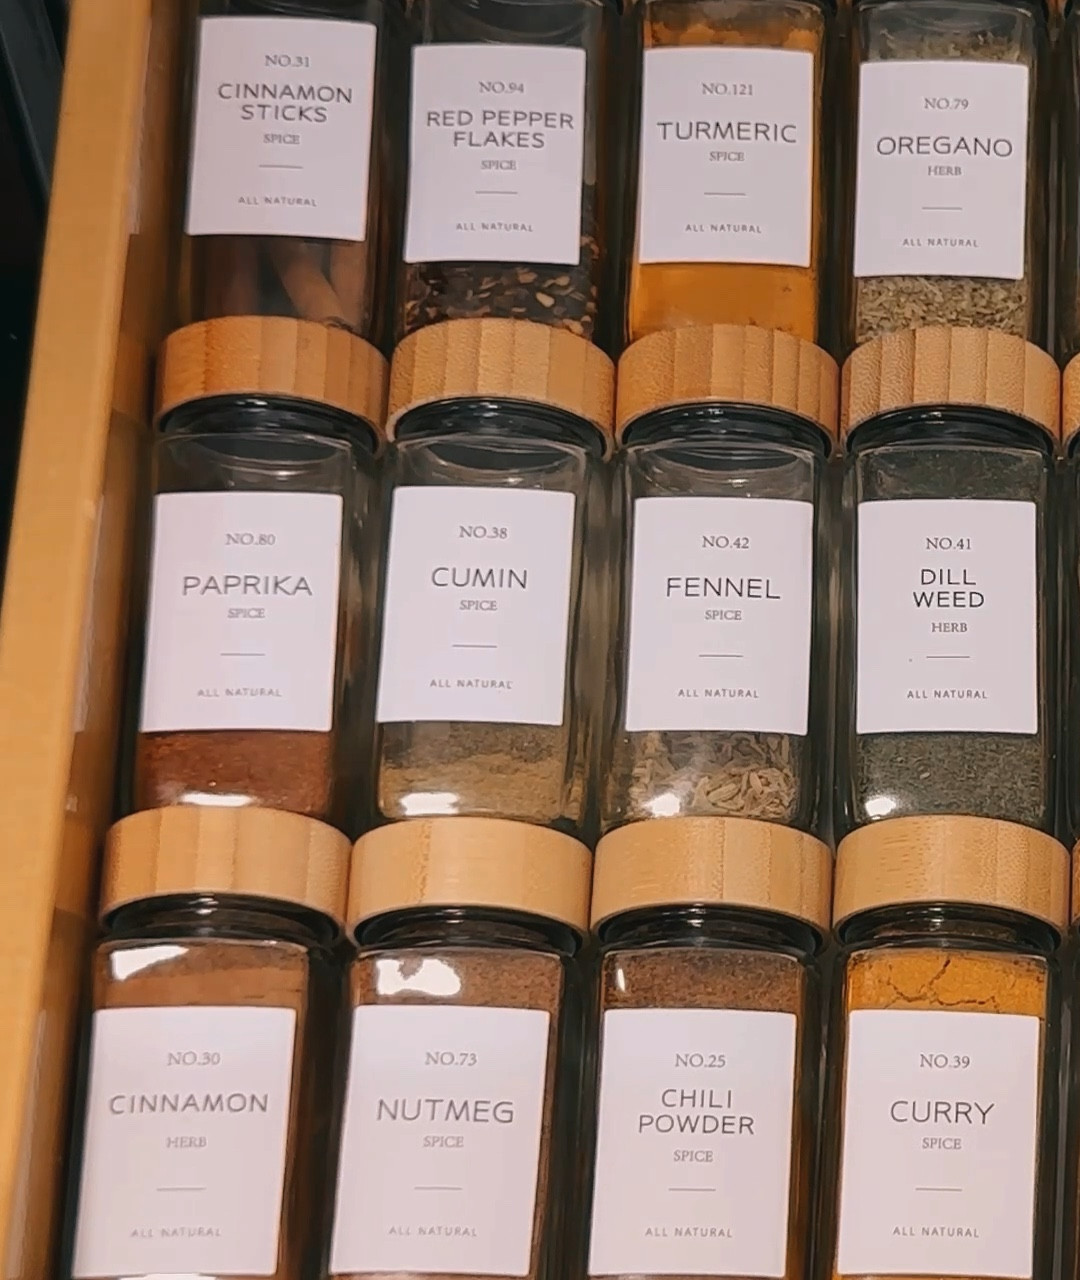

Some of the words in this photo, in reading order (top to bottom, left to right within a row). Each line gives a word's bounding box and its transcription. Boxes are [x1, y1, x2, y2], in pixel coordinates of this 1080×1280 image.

[265, 55, 309, 67] NO.31
[479, 81, 524, 93] NO.94
[702, 83, 752, 95] NO.121
[218, 83, 351, 104] CINNAMON
[925, 98, 969, 109] NO.79
[241, 104, 329, 122] STICKS
[427, 110, 473, 126] RED
[483, 110, 573, 129] PEPPER
[657, 122, 796, 142] TURMERIC
[263, 133, 299, 144] SPICE
[454, 131, 544, 148] FLAKES
[877, 136, 1012, 157] OREGANO
[709, 151, 744, 161] SPICE
[481, 160, 516, 170] SPICE
[928, 166, 961, 176] HERB
[238, 197, 259, 206] ALL
[264, 197, 317, 207] NATURAL
[456, 223, 476, 231] ALL
[481, 222, 533, 233] NATURAL
[686, 224, 705, 233] ALL
[711, 224, 762, 234] NATURAL
[903, 238, 922, 247] ALL
[928, 238, 978, 248] NATURAL
[460, 526, 507, 539] NO.38
[226, 533, 275, 545] NO.80
[702, 536, 749, 549] NO.42
[926, 538, 970, 549] NO.41
[432, 568, 527, 588] CUMIN
[921, 569, 976, 585] DILL
[183, 575, 312, 595] PAPRIKA
[667, 578, 780, 599] FENNEL
[459, 600, 497, 611] SPICE
[913, 591, 984, 608] WEED
[227, 608, 265, 618] SPICE
[705, 610, 741, 620] SPICE
[932, 623, 967, 632] HERB
[430, 680, 452, 689] ALL
[457, 679, 512, 690] NATURAL
[197, 689, 220, 698] ALL
[225, 688, 282, 698] NATURAL
[678, 689, 699, 698] ALL
[705, 688, 759, 699] NATURAL
[907, 690, 929, 700] ALL
[934, 690, 988, 699] NATURAL
[167, 1051, 220, 1066] NO.30
[425, 1052, 477, 1066] NO.73
[675, 1053, 725, 1068] NO.25
[920, 1054, 970, 1068] NO.39
[109, 1093, 268, 1114] CINNAMON
[662, 1089, 731, 1108] CHILI
[377, 1099, 513, 1123] NUTMEG
[891, 1101, 994, 1124] CURRY
[639, 1115, 753, 1134] POWDER
[166, 1137, 206, 1148] HERB
[423, 1136, 464, 1148] SPICE
[922, 1138, 961, 1150] SPICE
[674, 1150, 713, 1162] SPICE
[131, 1229, 156, 1238] ALL
[161, 1227, 221, 1238] NATURAL
[389, 1226, 411, 1237] ALL
[419, 1226, 478, 1238] NATURAL
[645, 1228, 668, 1238] ALL
[675, 1227, 733, 1239] NATURAL
[893, 1227, 916, 1237] ALL
[922, 1227, 980, 1239] NATURAL
